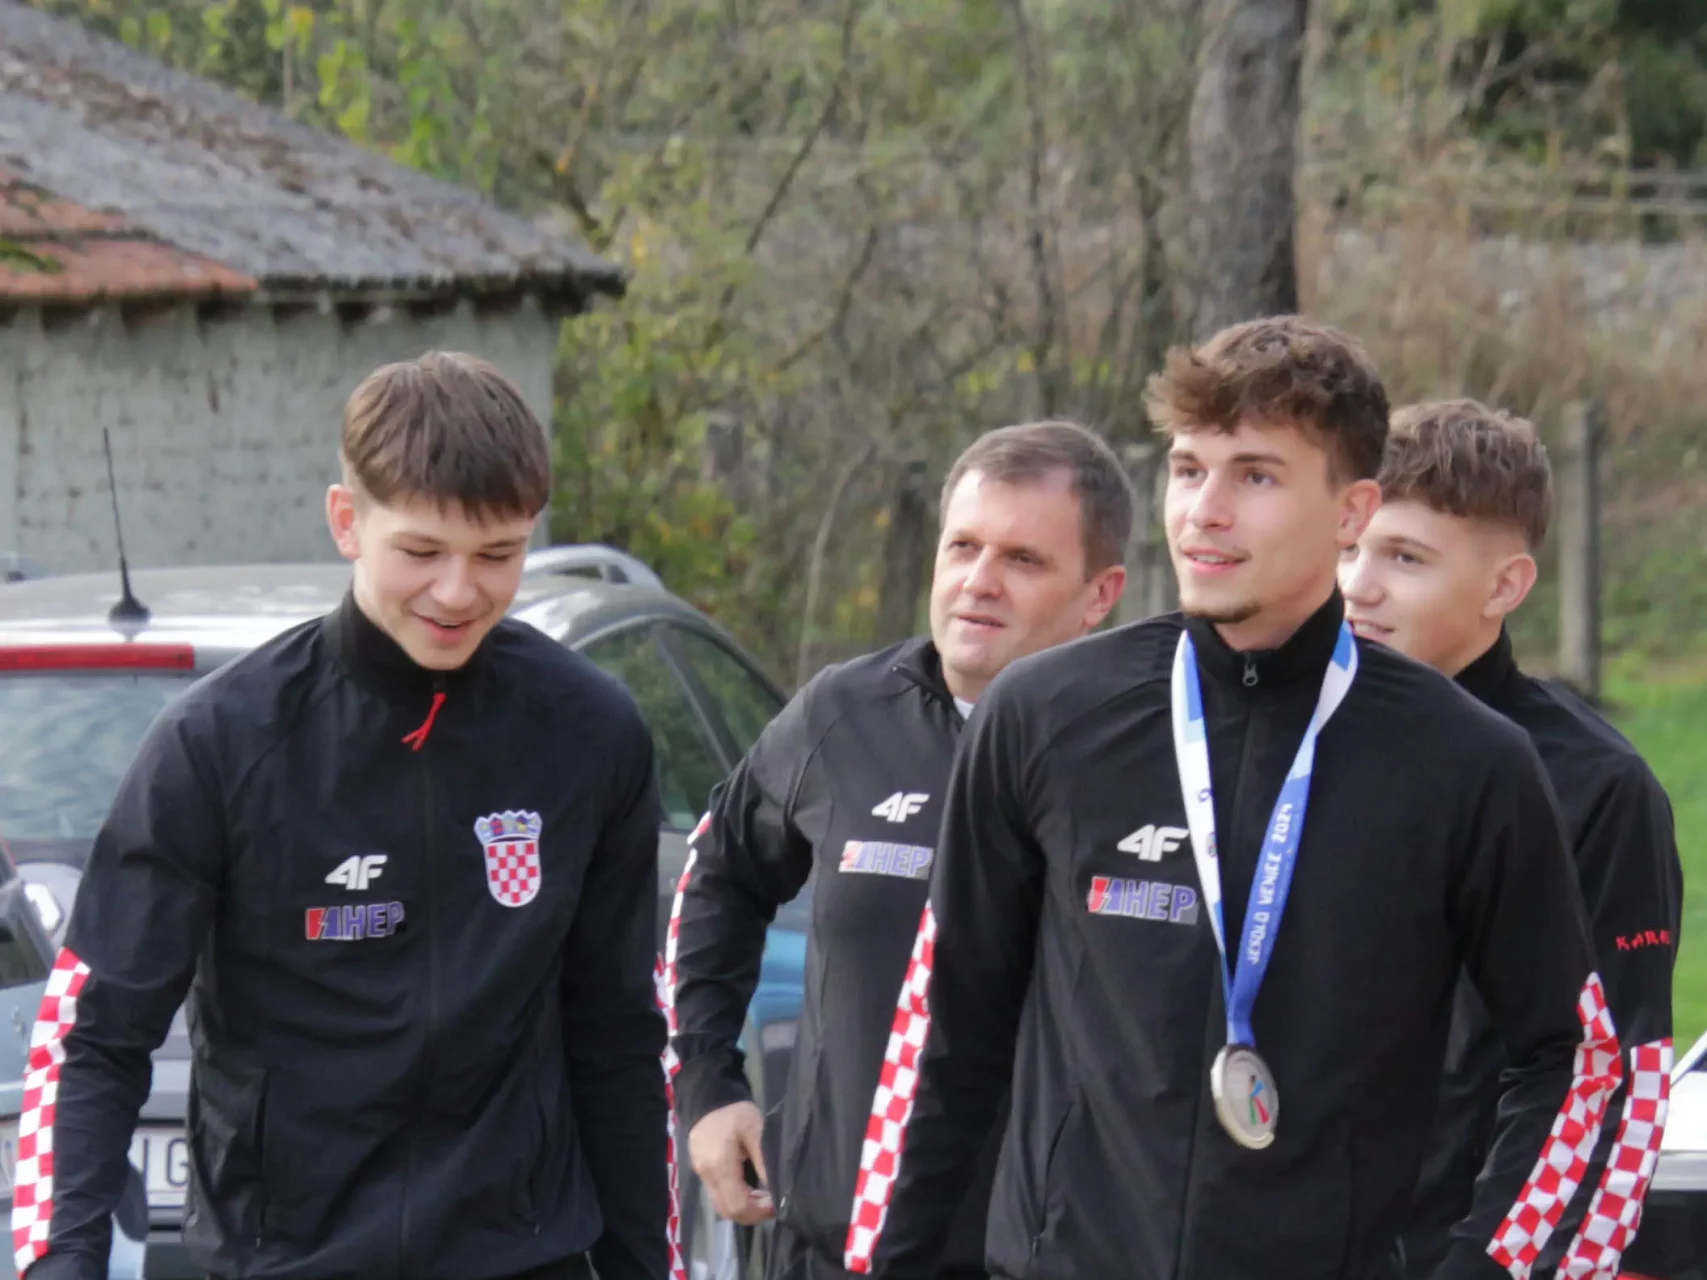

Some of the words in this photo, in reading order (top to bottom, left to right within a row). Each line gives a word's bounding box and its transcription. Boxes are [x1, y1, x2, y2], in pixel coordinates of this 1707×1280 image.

[871, 791, 930, 823] 4F
[868, 841, 932, 880] HEP
[1117, 823, 1190, 862] 4F
[324, 854, 388, 890] 4F
[1121, 879, 1197, 922] HEP
[342, 901, 405, 940] HEP
